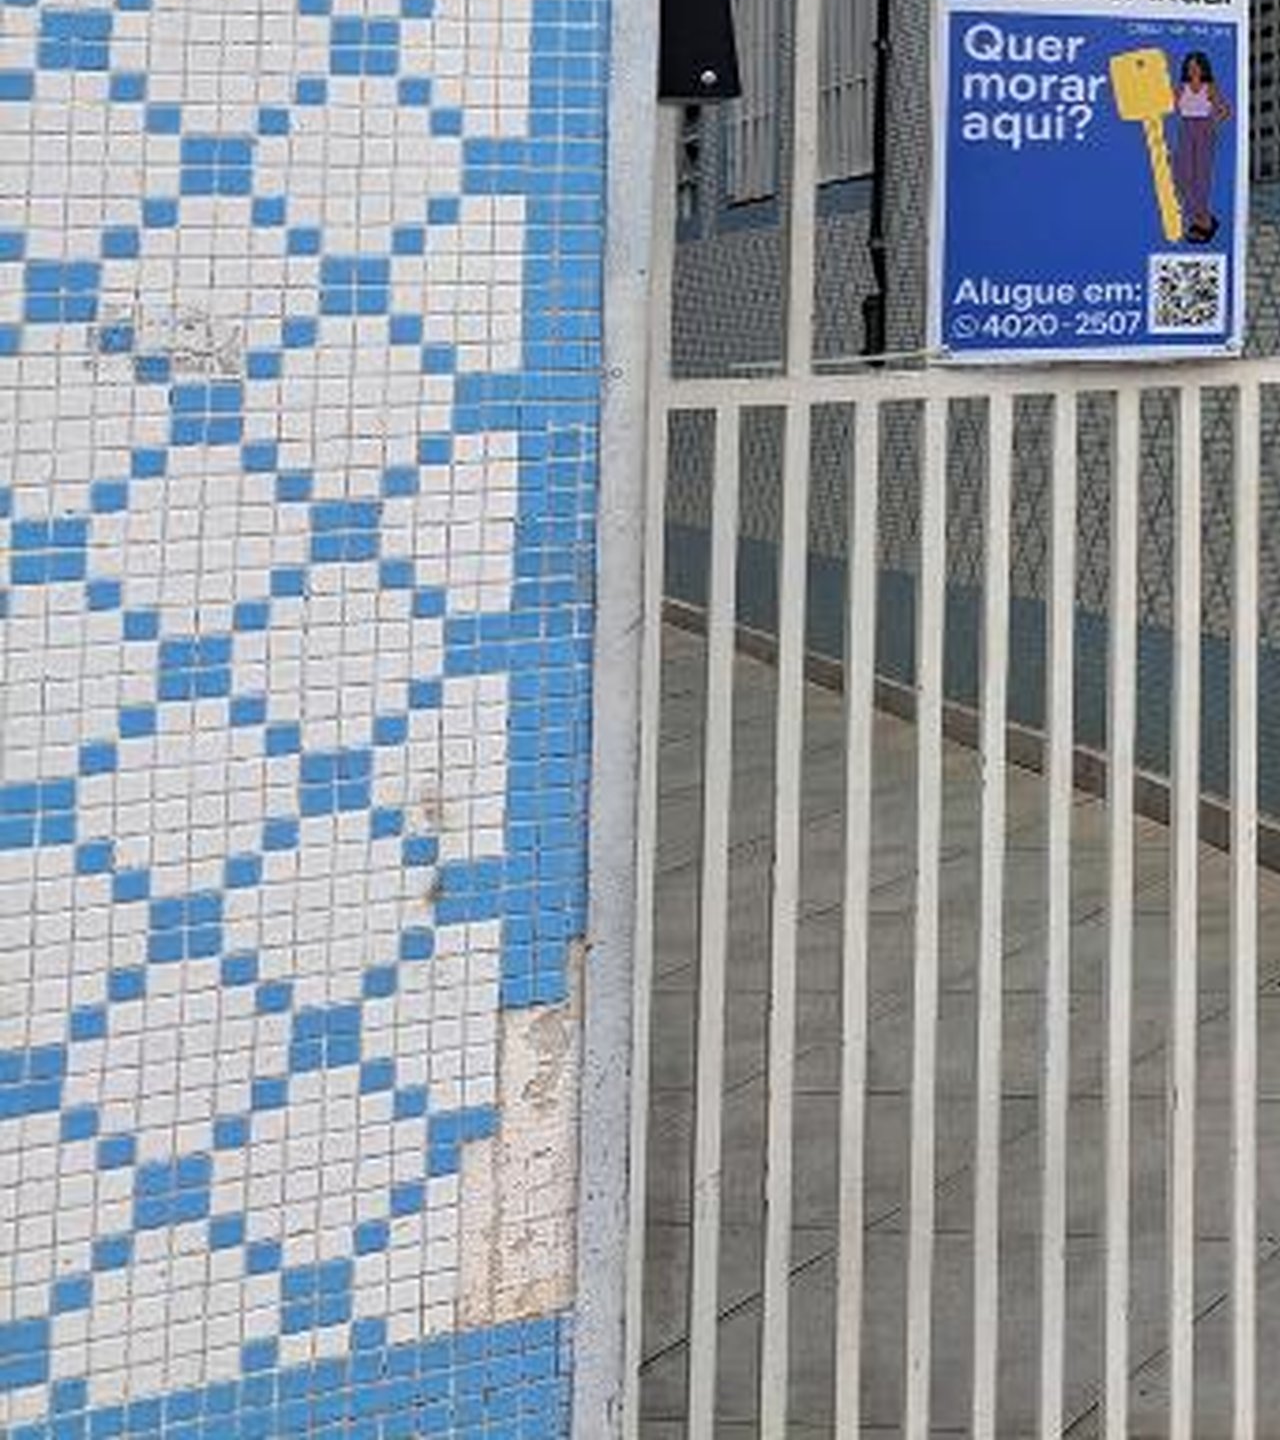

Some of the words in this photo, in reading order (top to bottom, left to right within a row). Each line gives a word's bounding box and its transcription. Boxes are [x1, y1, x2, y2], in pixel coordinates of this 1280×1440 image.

[962, 23, 1086, 62] Quer
[962, 72, 1107, 103] morar
[962, 104, 1094, 150] aqui?
[953, 277, 1078, 310] Alugue
[1082, 281, 1143, 303] em:
